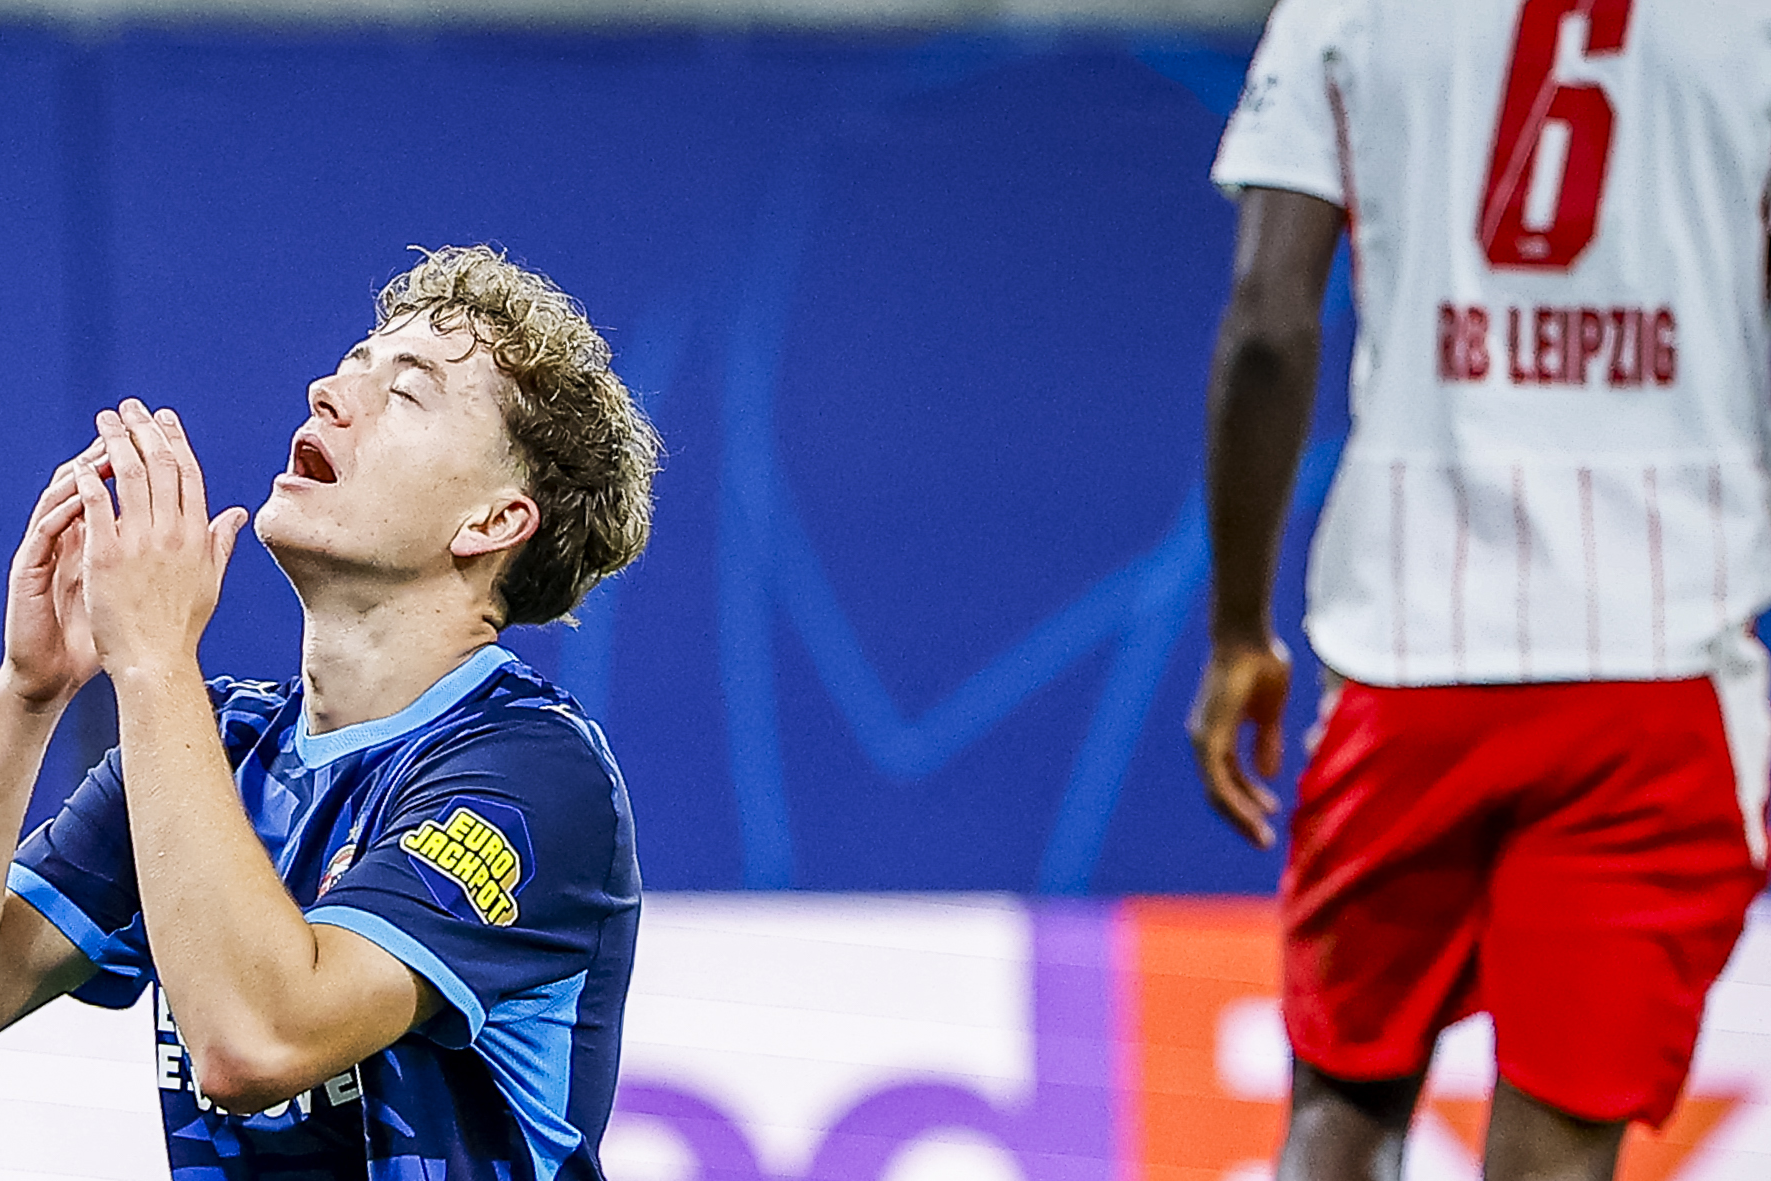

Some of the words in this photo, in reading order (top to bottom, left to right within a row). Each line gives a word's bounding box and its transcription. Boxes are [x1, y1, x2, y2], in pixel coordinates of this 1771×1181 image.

[1478, 0, 1630, 272] 6
[1436, 302, 1489, 382] RB
[1507, 306, 1676, 386] LEIPZIG
[404, 825, 511, 924] JACKPOT
[446, 812, 515, 880] EURO
